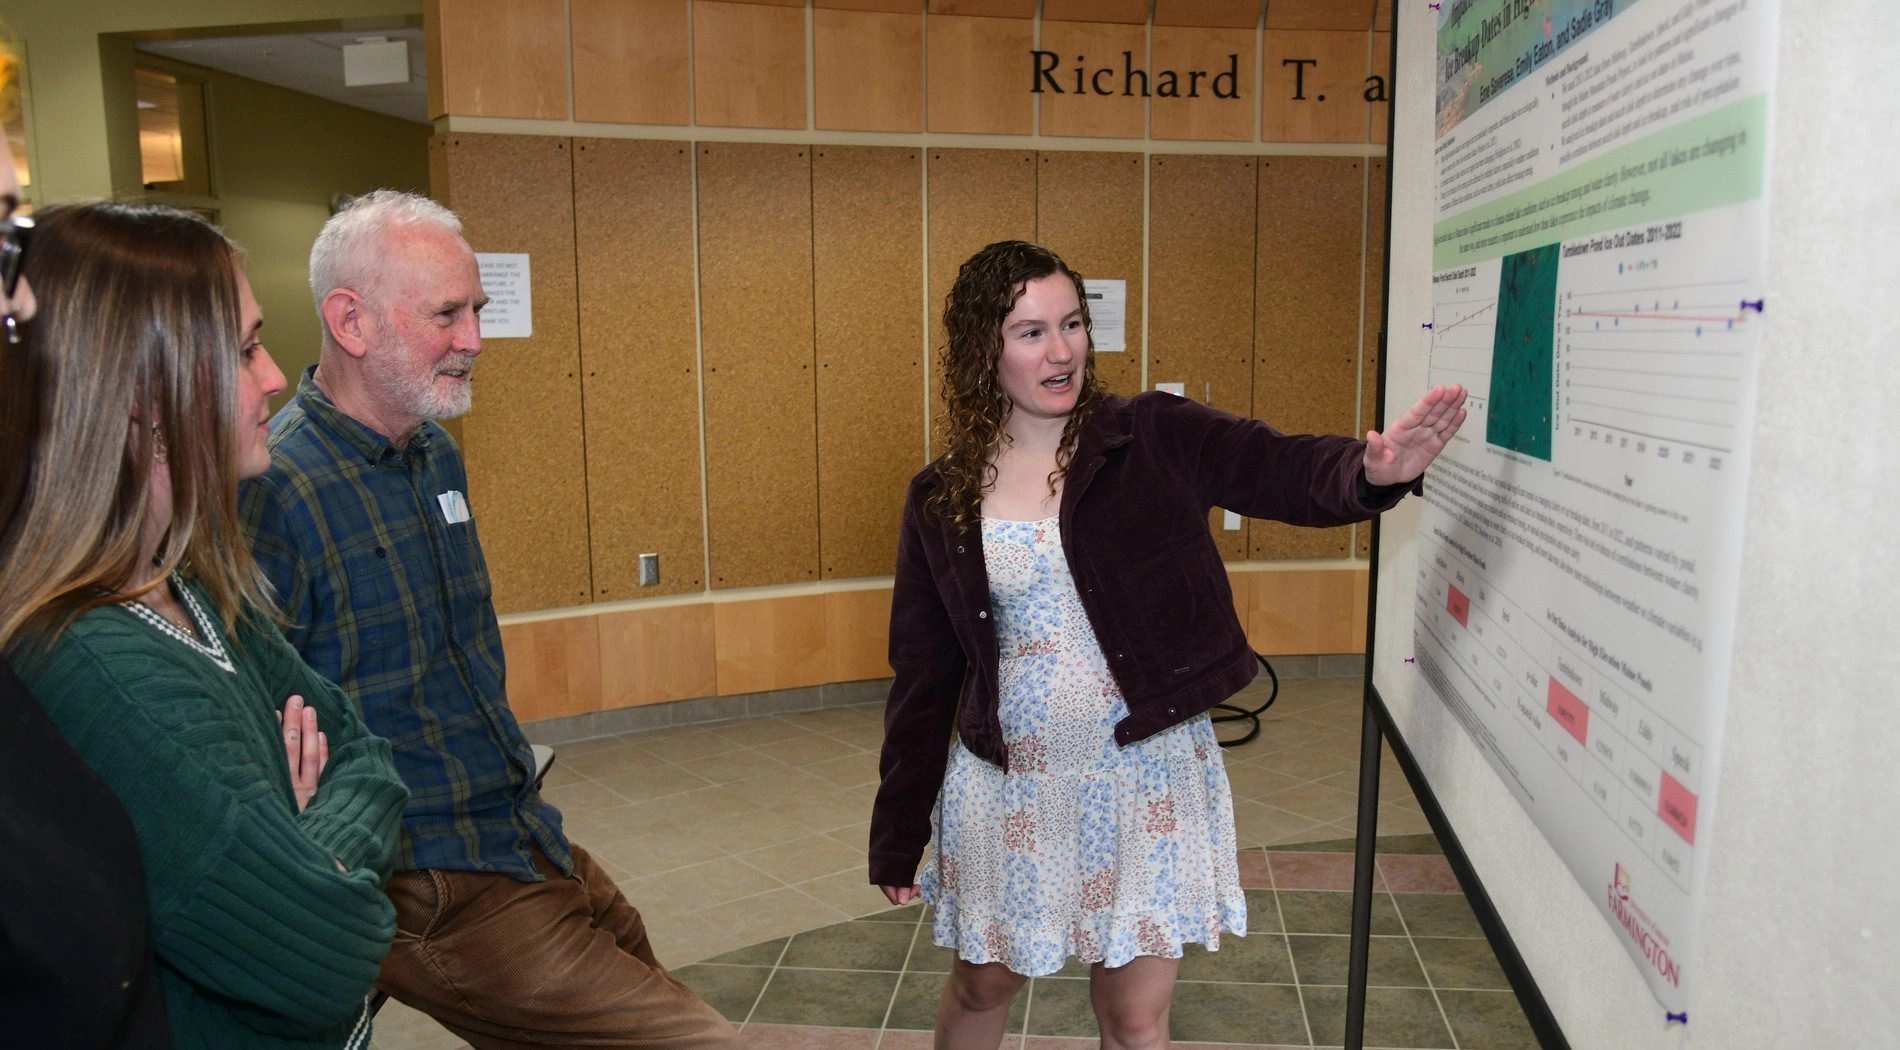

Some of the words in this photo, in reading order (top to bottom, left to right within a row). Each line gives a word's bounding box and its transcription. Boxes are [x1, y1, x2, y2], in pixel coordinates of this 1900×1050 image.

[1454, 33, 1480, 74] Breakup
[1481, 12, 1501, 49] Dates
[1503, 0, 1511, 29] in
[1513, 0, 1536, 20] Hig
[1516, 52, 1532, 77] Emily
[1556, 23, 1570, 50] and
[1571, 9, 1592, 39] Sadie
[1594, 0, 1613, 22] Gray
[1030, 50, 1240, 100] Richard
[1282, 58, 1326, 102] T.
[1626, 230, 1645, 247] Dates
[1607, 883, 1681, 990] FARMINGTON
